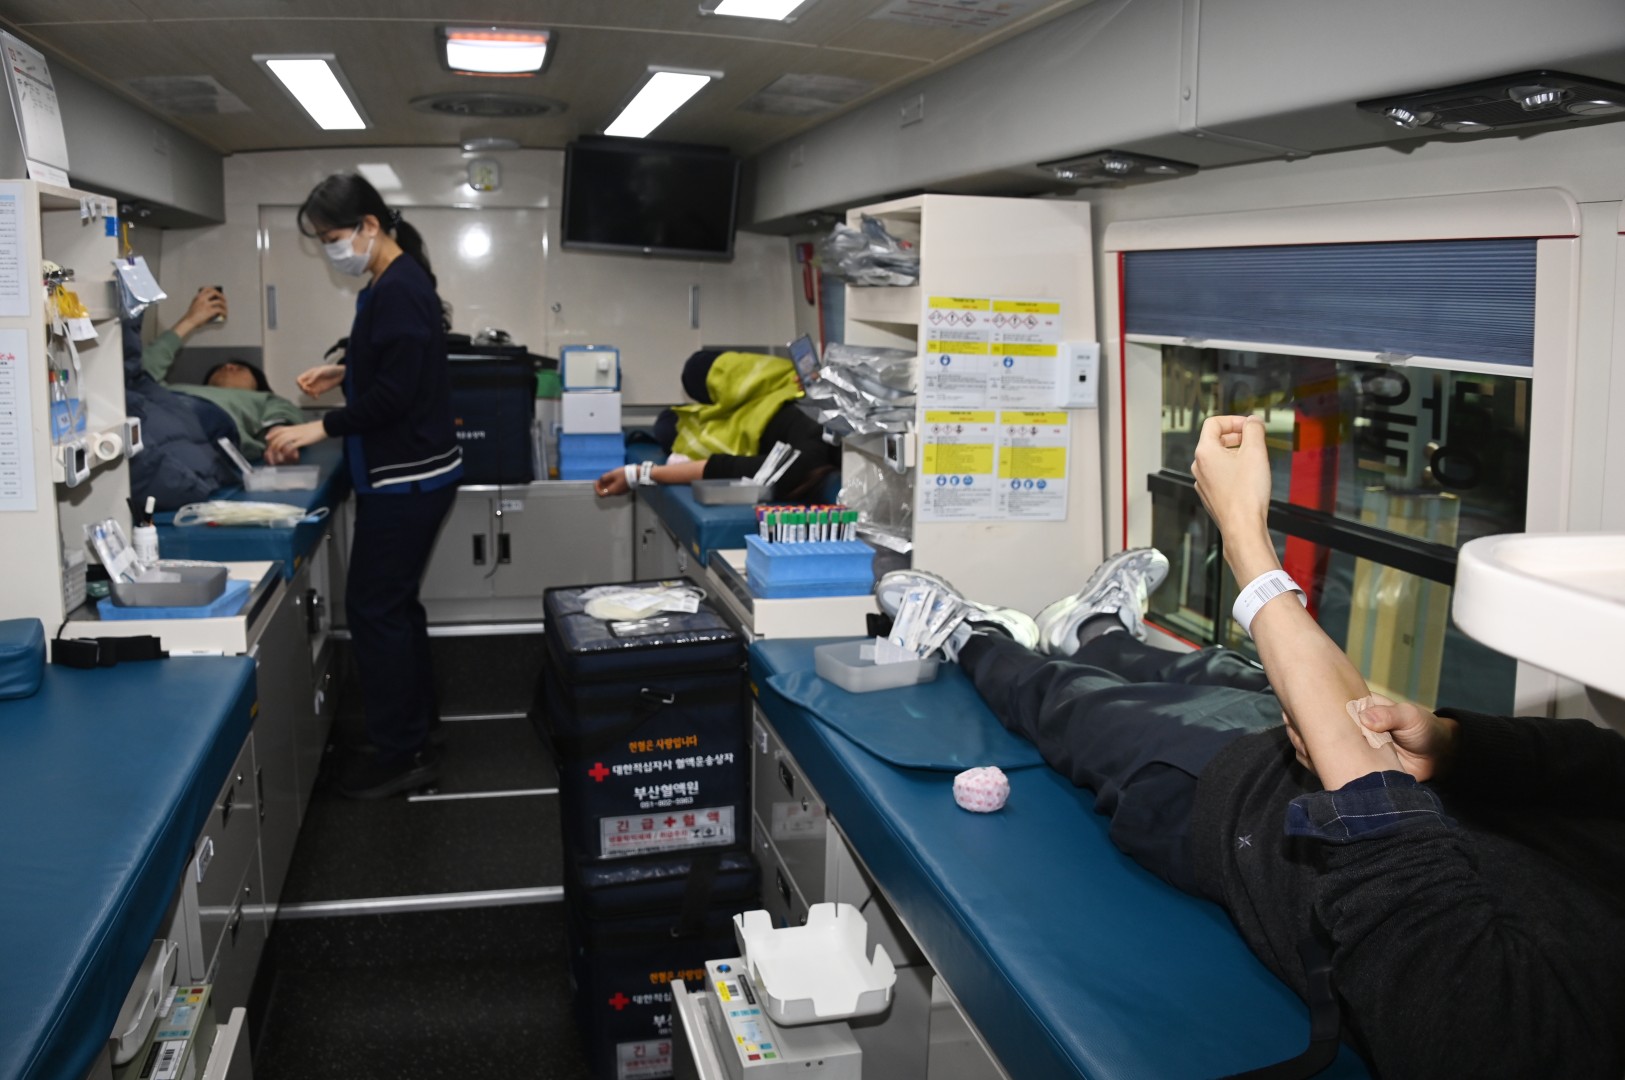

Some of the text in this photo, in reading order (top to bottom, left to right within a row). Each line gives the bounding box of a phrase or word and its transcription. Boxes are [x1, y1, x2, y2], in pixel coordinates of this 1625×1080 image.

[629, 735, 698, 753] 헌혈은 사랑입니다
[612, 753, 734, 775] 대한적십자사 혈액운송상자
[634, 781, 699, 800] 부산혈액원
